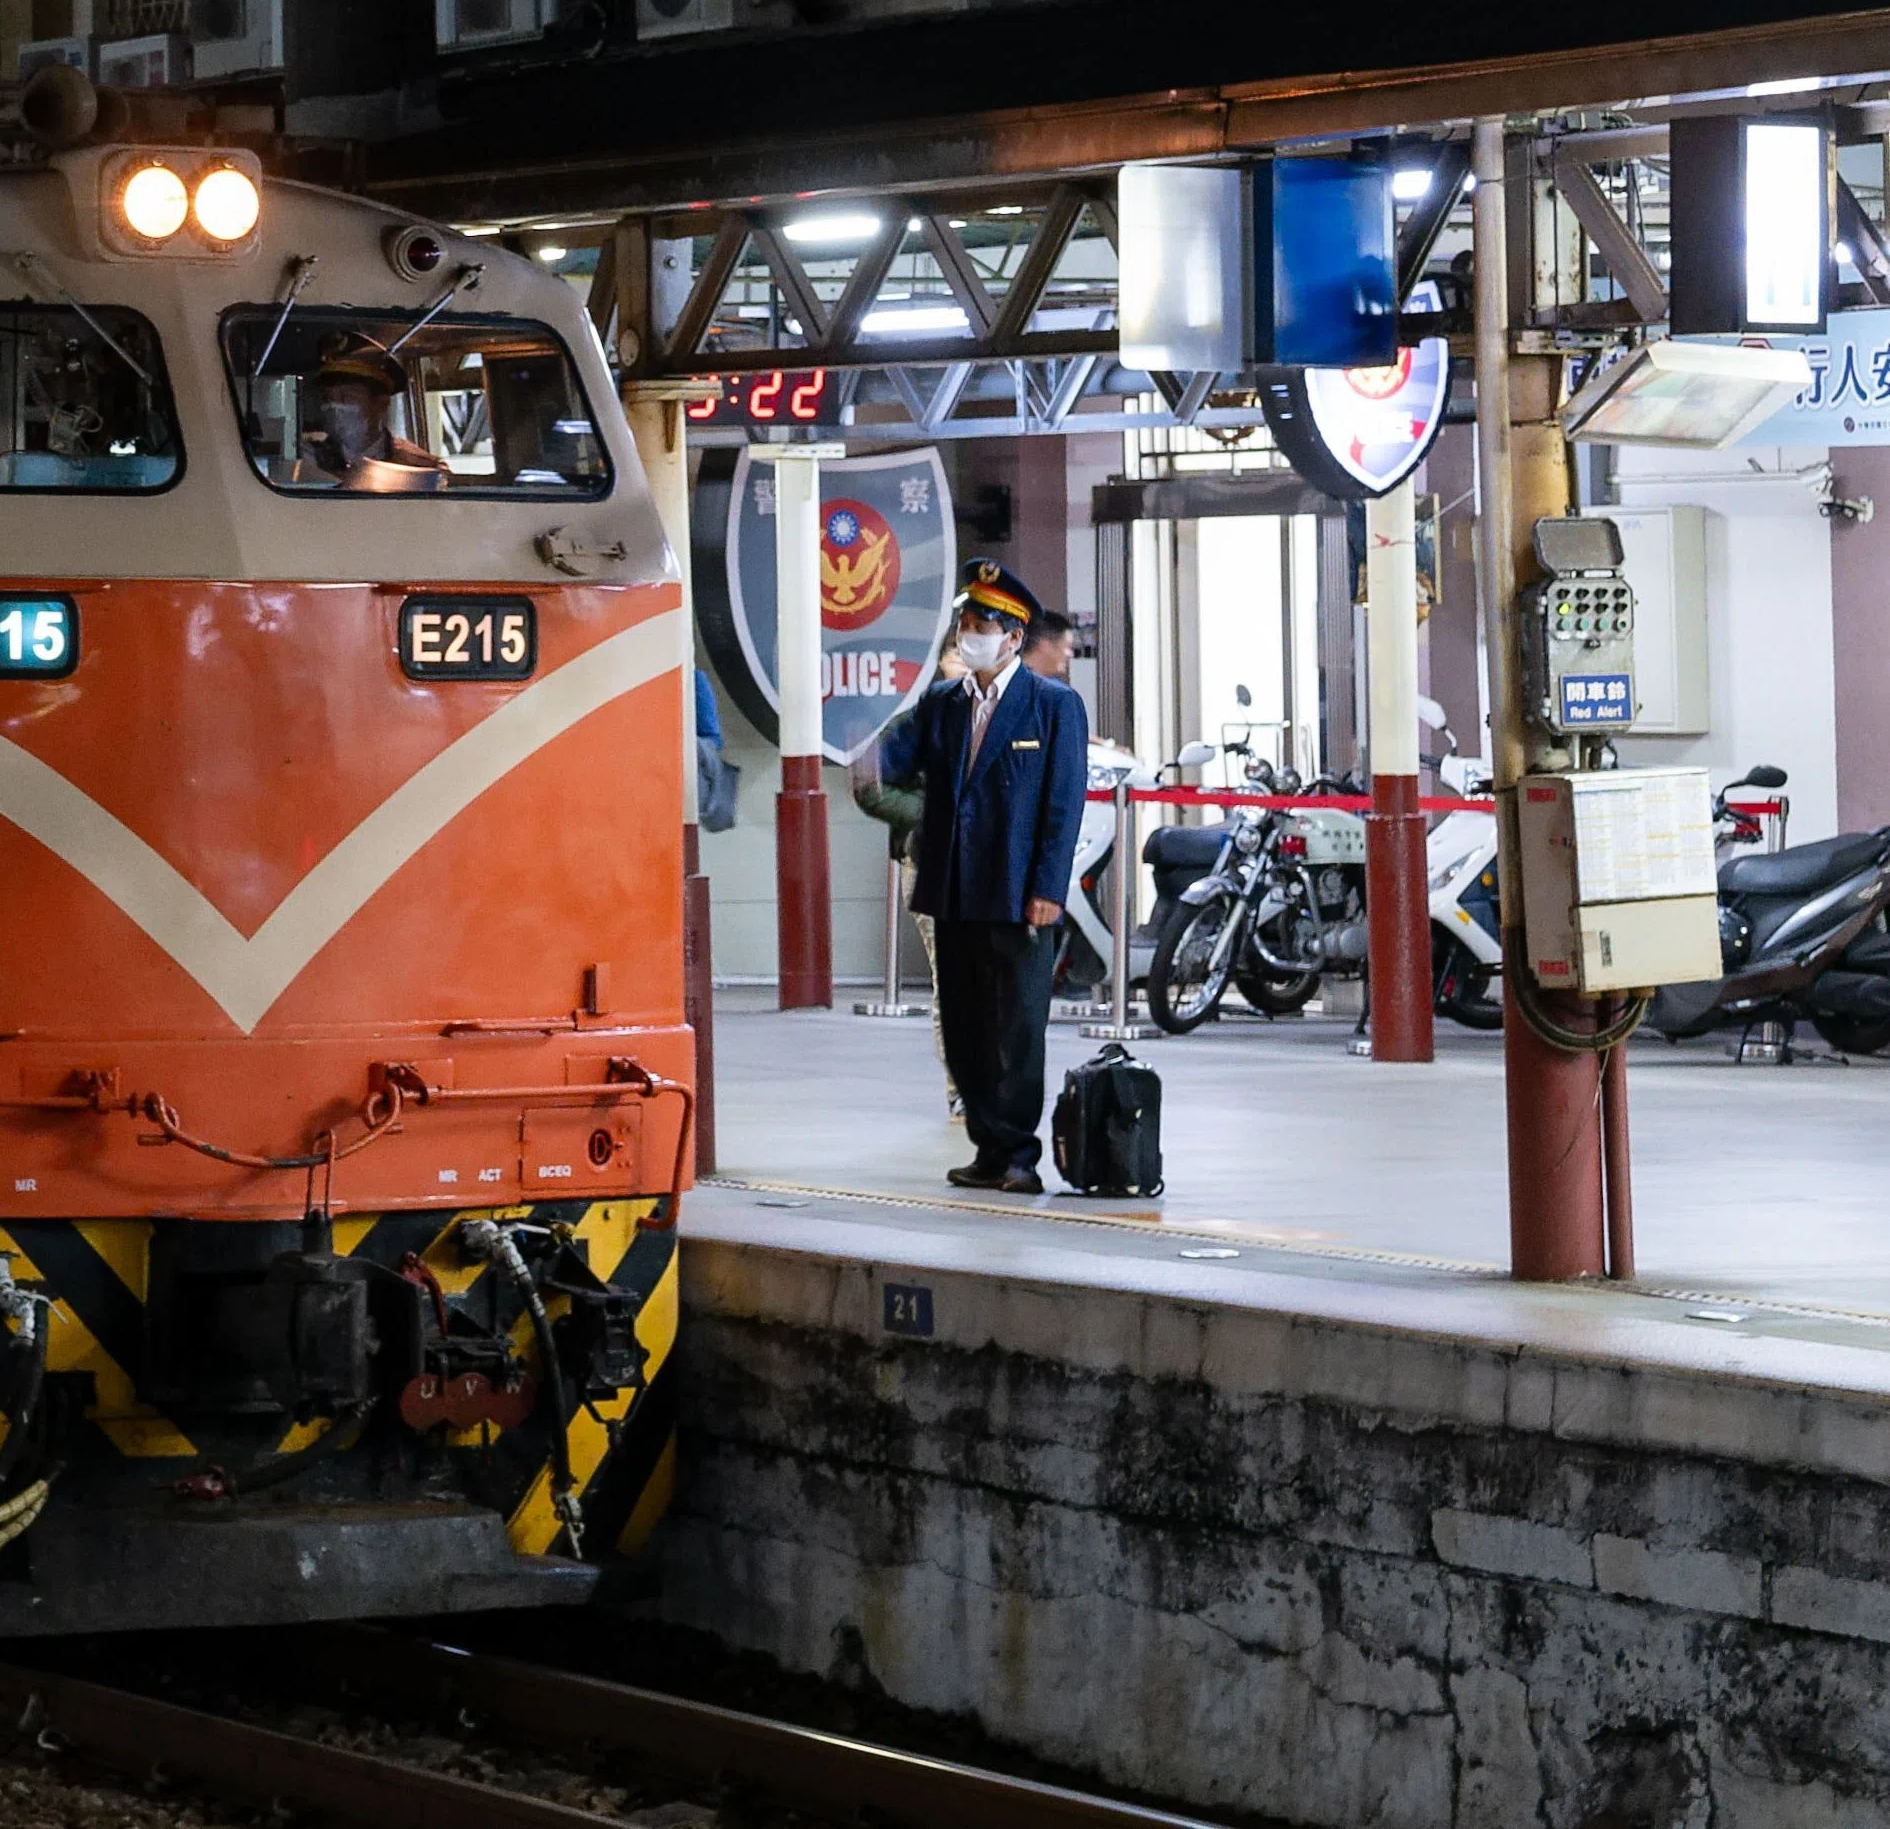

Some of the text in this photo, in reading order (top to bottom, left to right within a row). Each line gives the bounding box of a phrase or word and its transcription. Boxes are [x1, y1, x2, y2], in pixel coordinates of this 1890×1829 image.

[413, 614, 526, 663] E215
[1570, 705, 1622, 719] Red Alert
[478, 1168, 503, 1182] ACT
[538, 1164, 572, 1179] BCEQ
[14, 1178, 37, 1192] MR
[893, 1293, 918, 1322] 21
